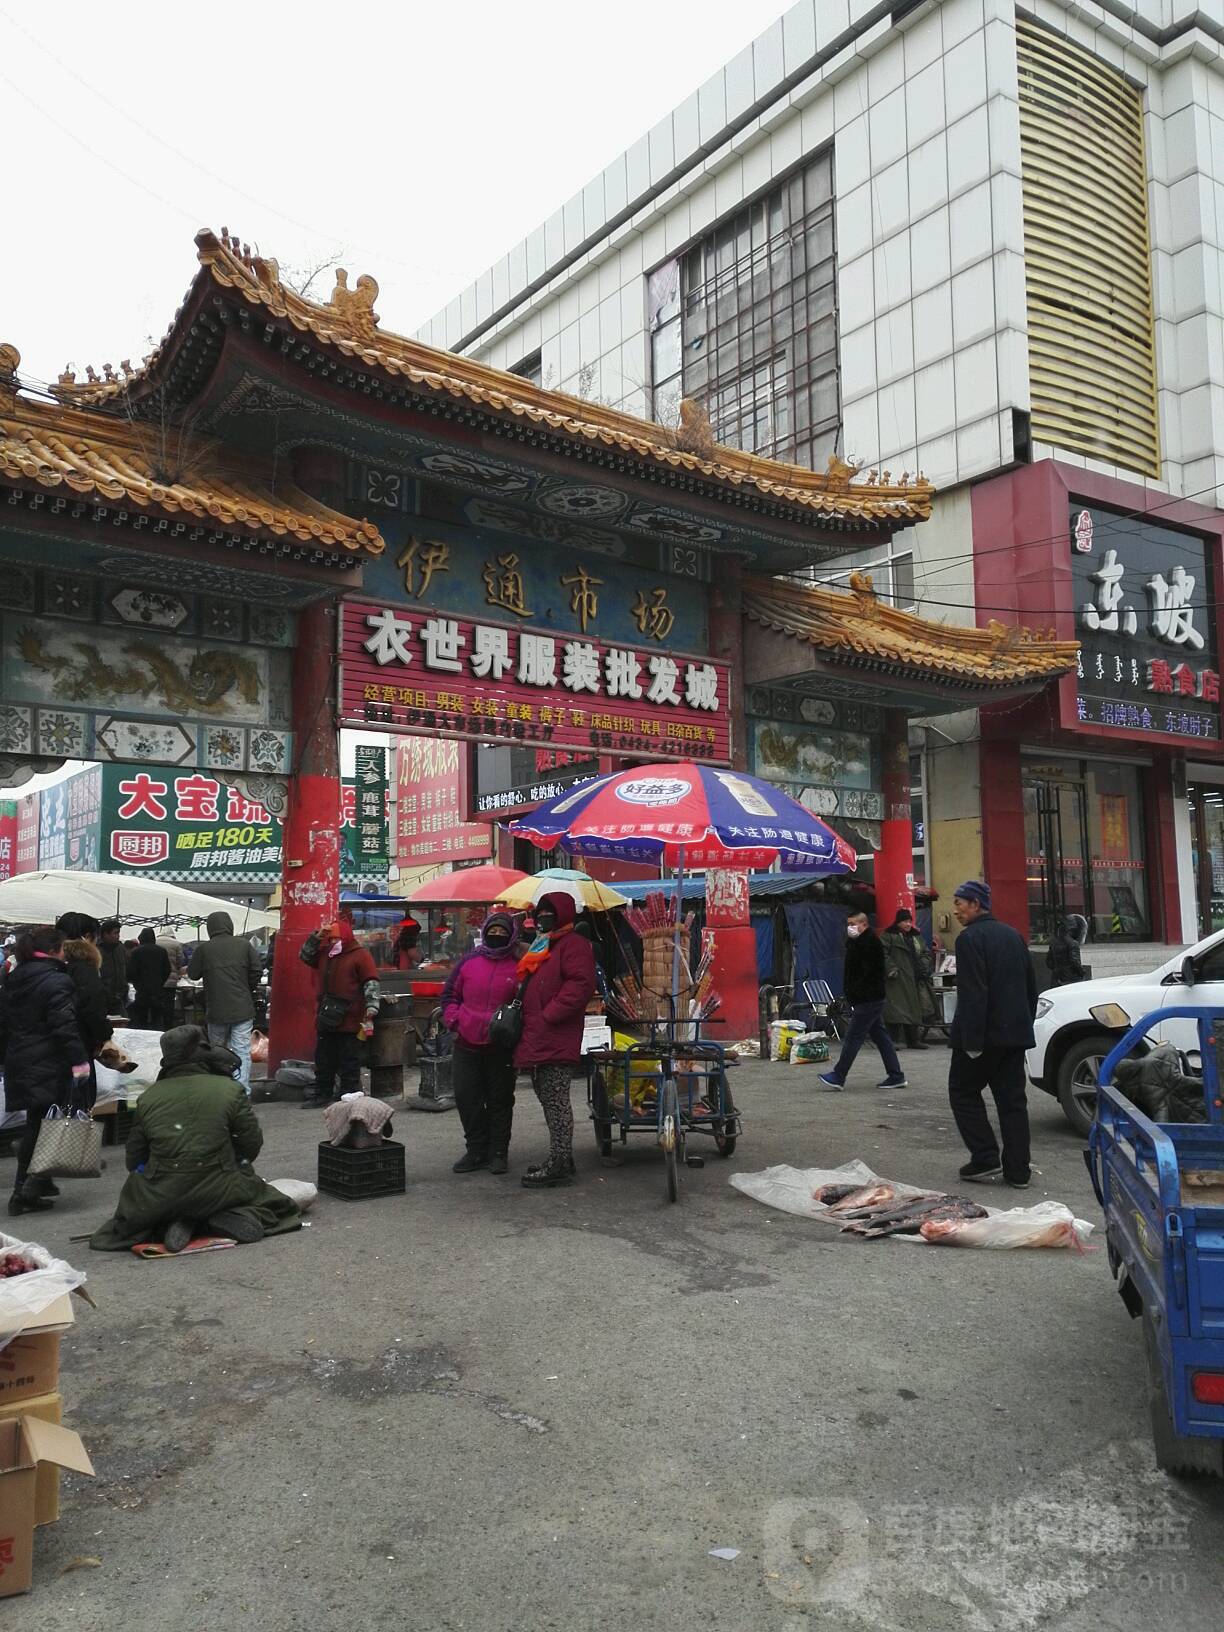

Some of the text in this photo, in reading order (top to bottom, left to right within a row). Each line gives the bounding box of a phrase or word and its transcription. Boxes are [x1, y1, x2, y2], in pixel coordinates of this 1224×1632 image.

[394, 538, 676, 641] 伊通市场
[1082, 549, 1205, 650] 东坡
[364, 609, 720, 713] 衣世界服装批发城
[1148, 657, 1221, 704] 熟食店
[363, 684, 716, 742] 经营项目 男装 女装 童装 裤子 鞋 床品针织 玩具 日杂百货 等
[361, 791, 380, 817] 鹿茸
[623, 782, 683, 796] 好益多
[118, 836, 162, 857] 厨邦
[175, 826, 273, 849] 晒足180天
[728, 825, 826, 848] 关注肠道健康
